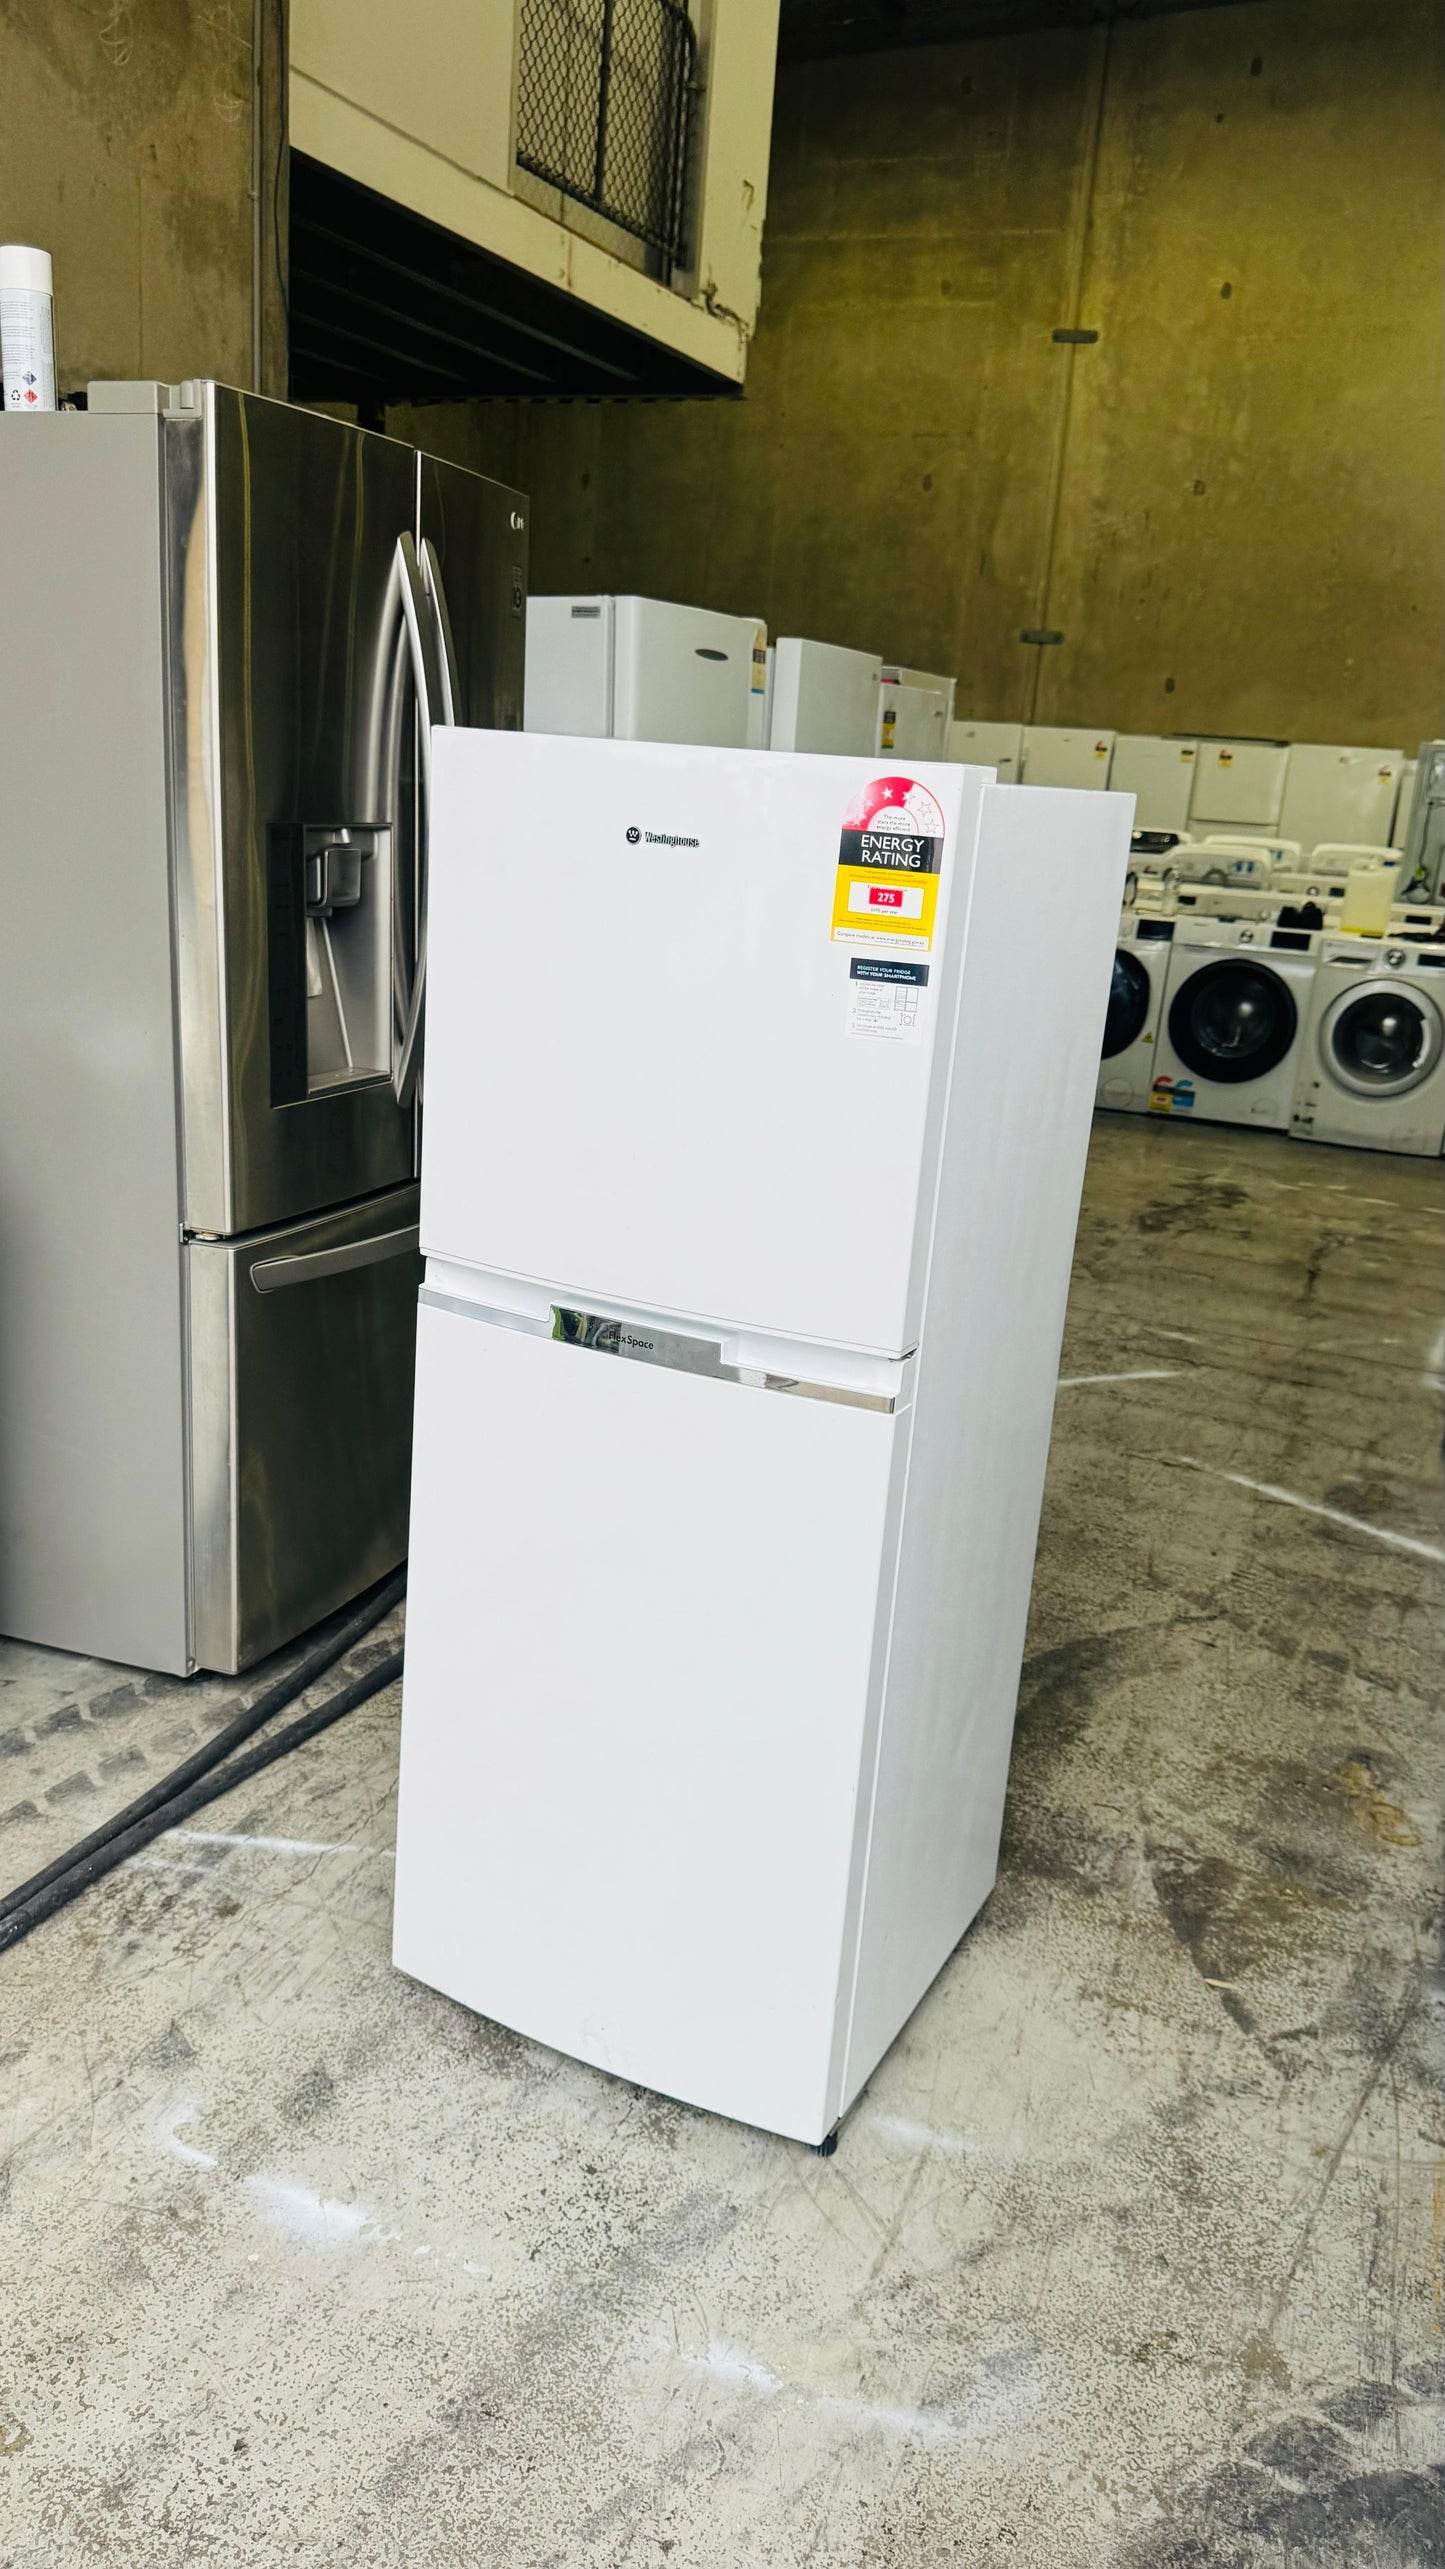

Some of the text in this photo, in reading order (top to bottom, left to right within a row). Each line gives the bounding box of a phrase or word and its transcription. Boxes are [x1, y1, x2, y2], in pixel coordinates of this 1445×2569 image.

[861, 834, 925, 853] ENERGY
[861, 850, 921, 868] RATING
[877, 893, 895, 903] 275
[883, 973, 917, 981] SMARTPHONE
[608, 1331, 654, 1350] FlexSpace
